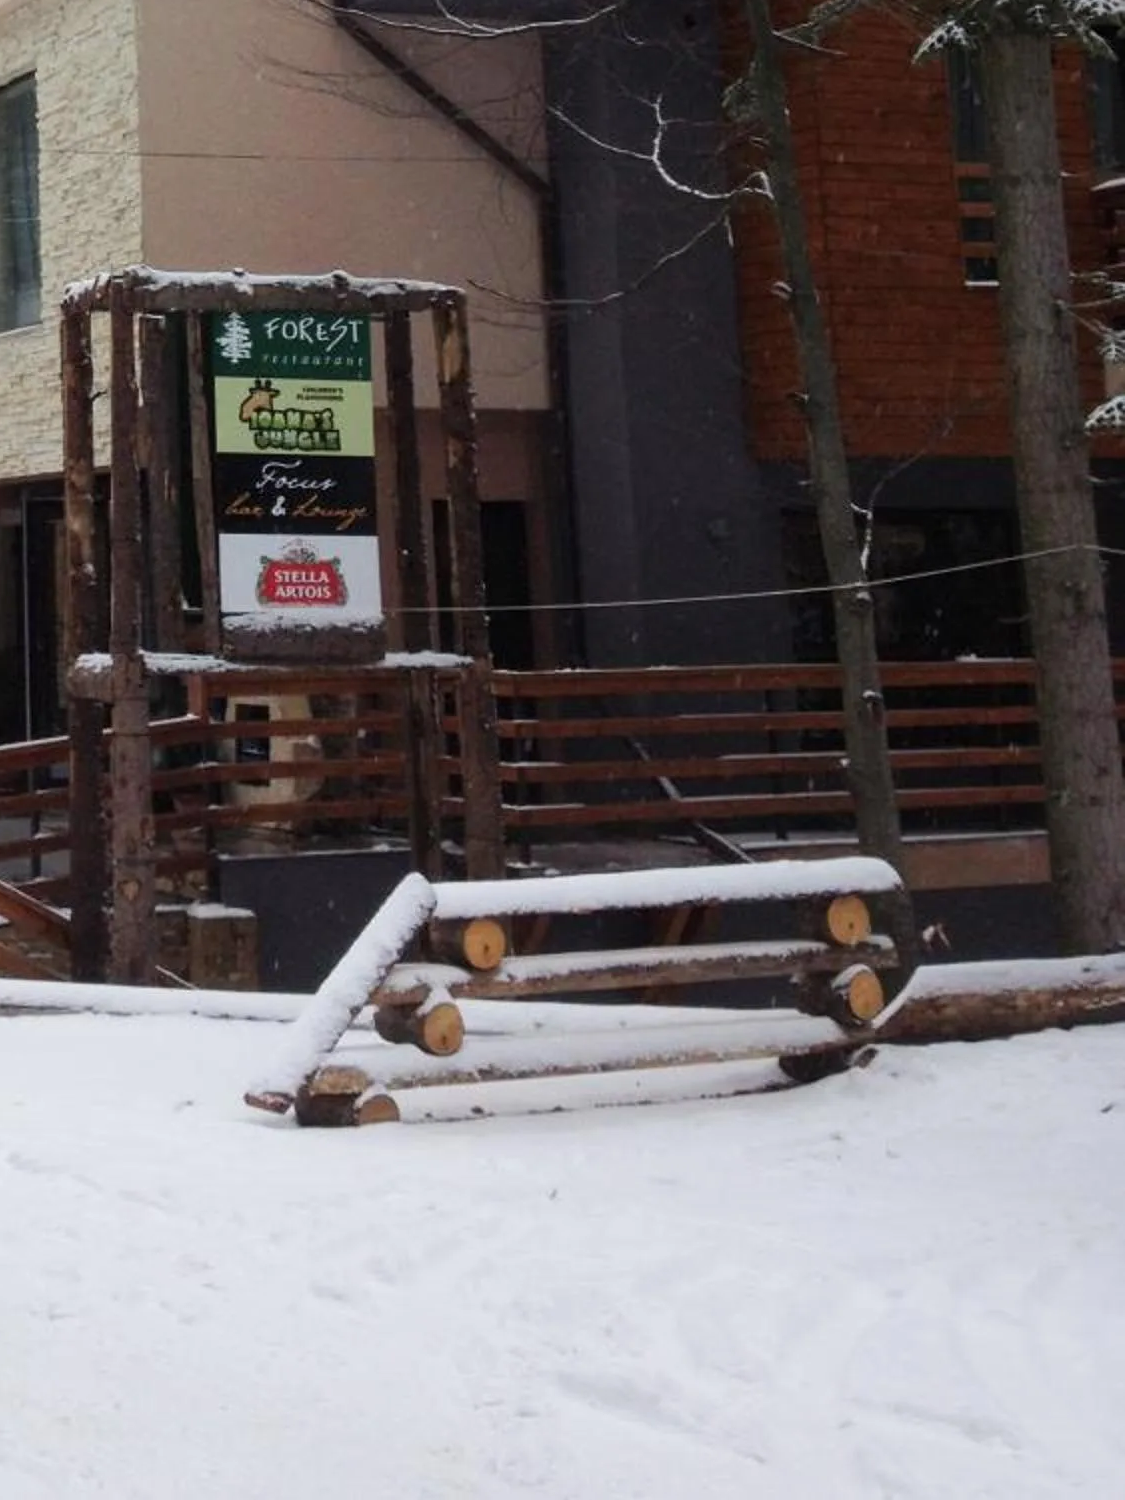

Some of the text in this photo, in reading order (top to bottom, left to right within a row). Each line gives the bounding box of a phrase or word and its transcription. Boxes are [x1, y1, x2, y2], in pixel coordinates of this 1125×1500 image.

[263, 317, 364, 352] FOREST
[256, 460, 338, 491] Focus
[271, 496, 286, 516] &
[274, 569, 330, 583] STELLA
[275, 585, 332, 599] ARTOIS
